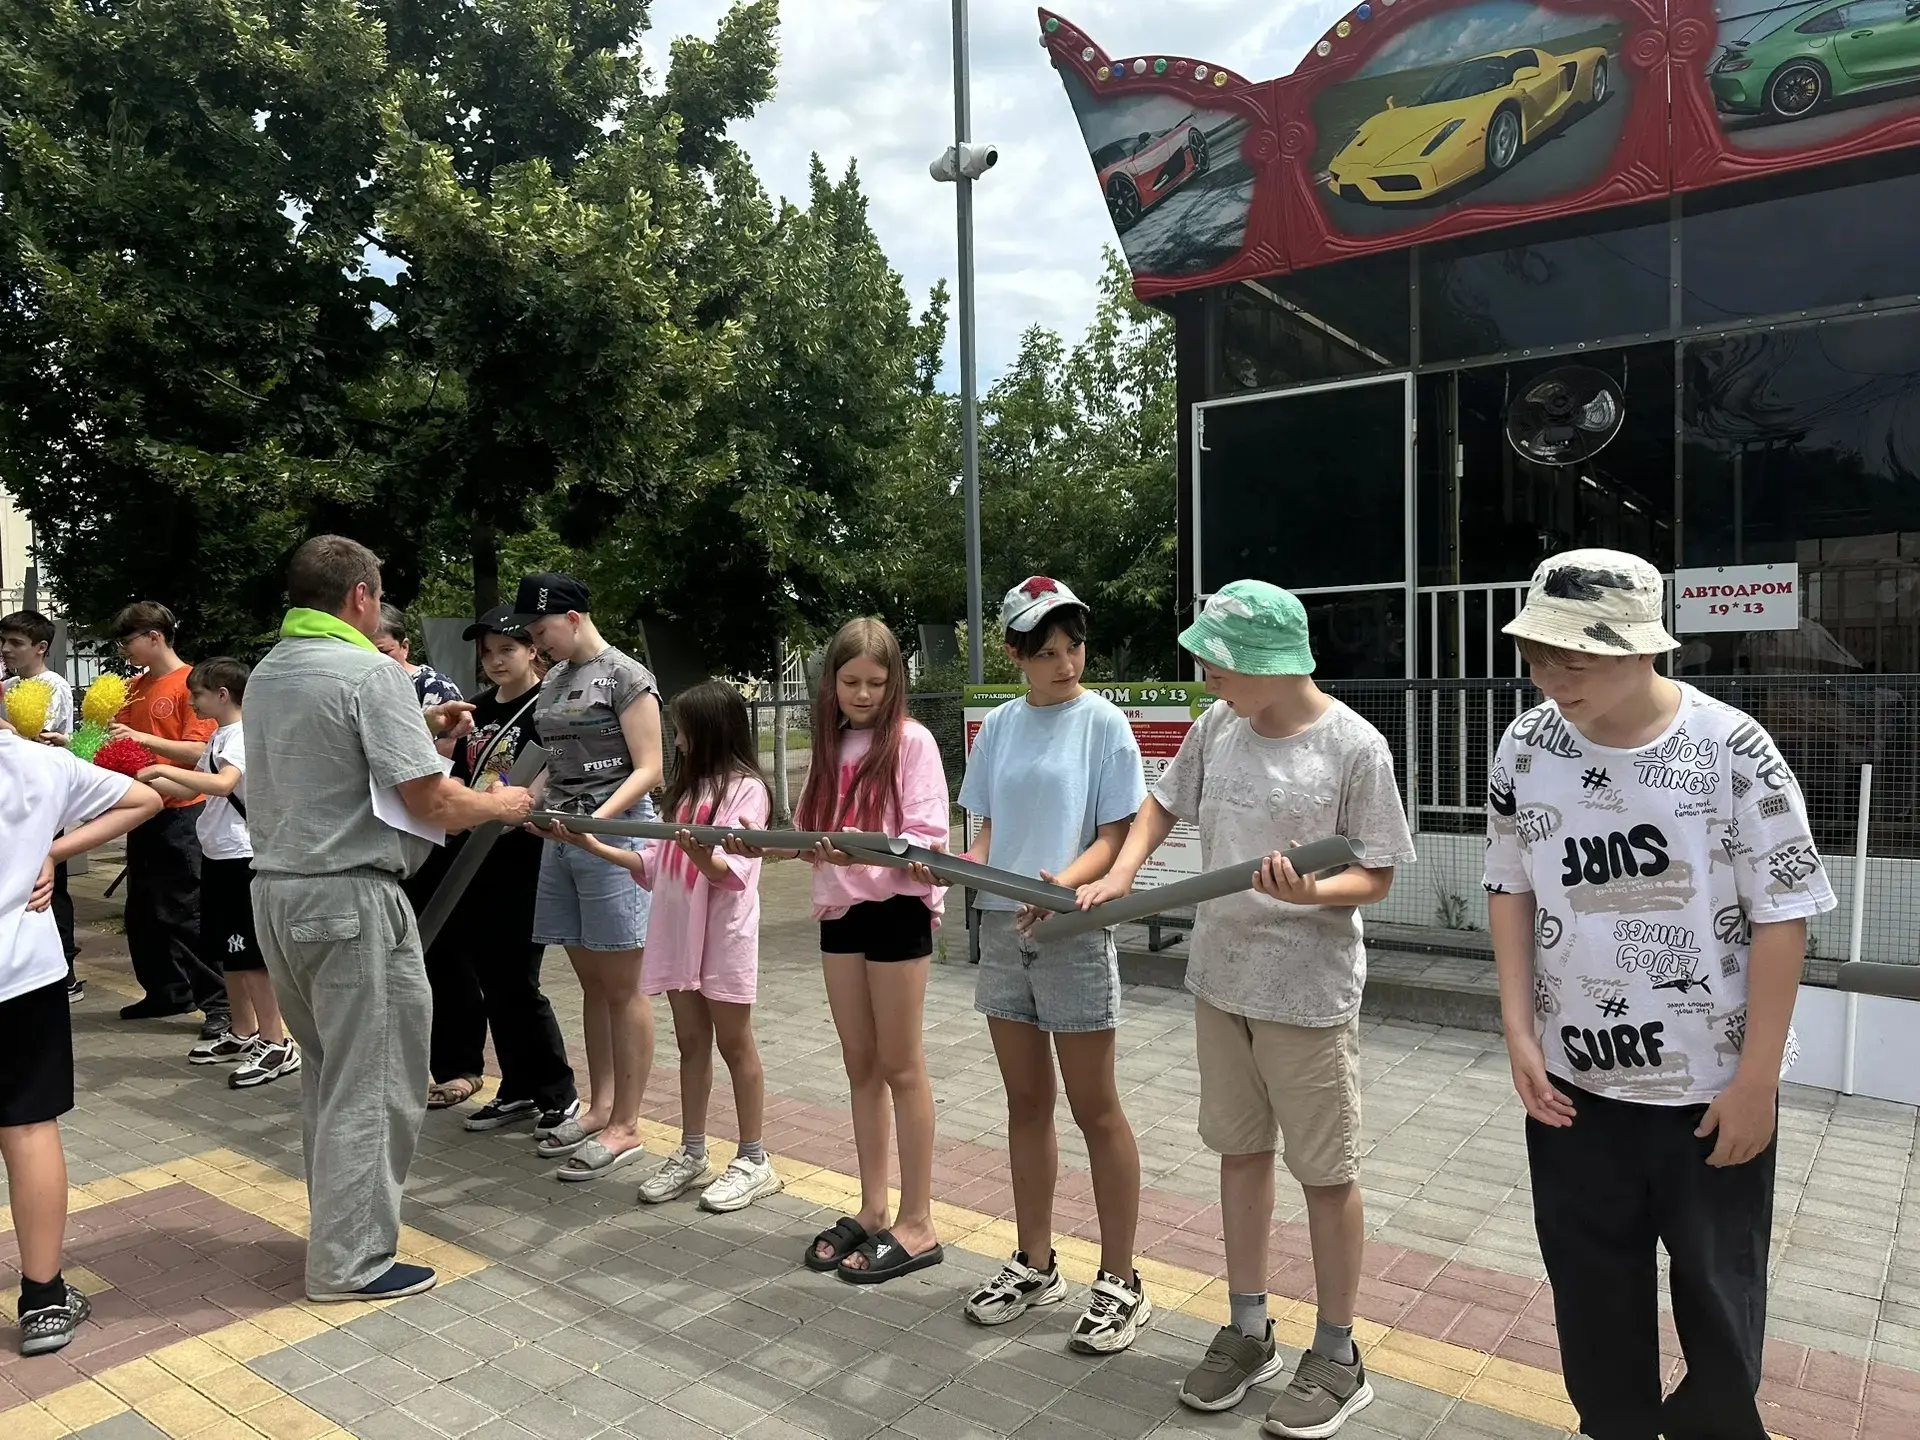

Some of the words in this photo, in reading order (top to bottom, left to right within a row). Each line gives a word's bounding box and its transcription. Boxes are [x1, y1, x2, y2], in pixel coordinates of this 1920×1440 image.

[1681, 582, 1793, 598] АВТОДРОМ
[583, 757, 624, 772] FUCK
[1633, 761, 1720, 795] THINGS
[1516, 808, 1536, 824] the
[1561, 823, 1670, 886] SURF
[1768, 845, 1800, 866] the
[1613, 919, 1701, 953] THINGS
[1560, 1021, 1665, 1072] SURF
